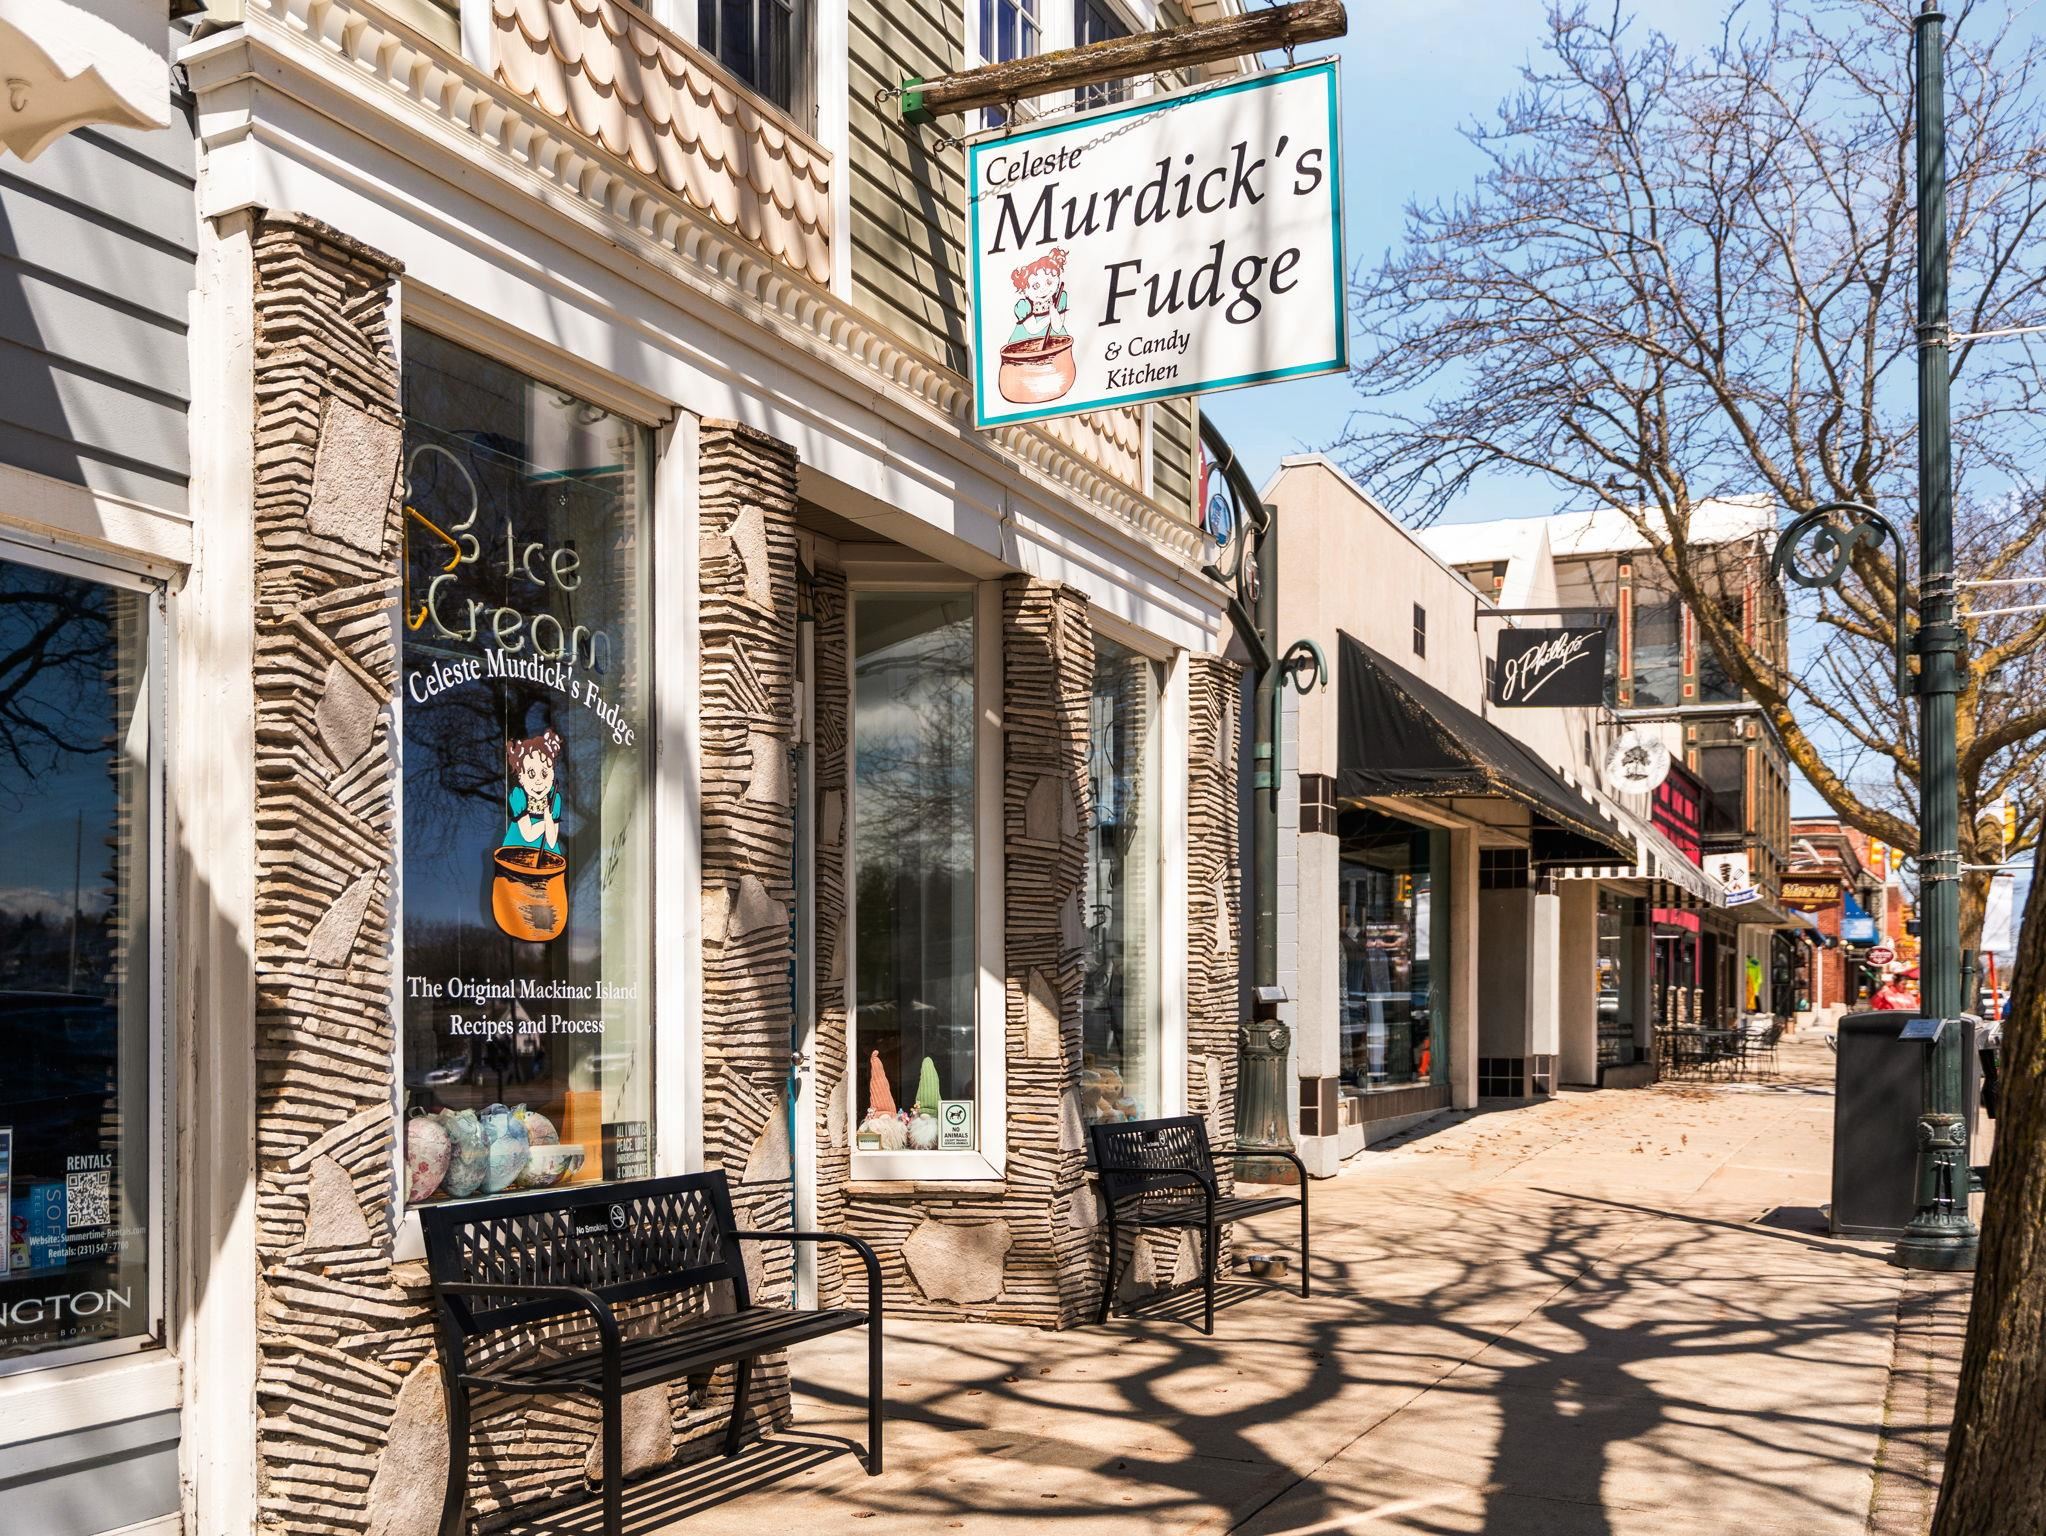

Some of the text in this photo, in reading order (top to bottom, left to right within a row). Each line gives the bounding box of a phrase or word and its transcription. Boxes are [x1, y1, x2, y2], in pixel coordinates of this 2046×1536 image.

[985, 145, 1083, 187] Celeste
[987, 135, 1323, 256] Murdick's
[1098, 239, 1301, 327] Fudge
[1104, 329, 1191, 362] & Candy
[1105, 363, 1179, 391] Kitchen
[504, 517, 582, 592] Ice
[428, 573, 612, 675] Cream
[1502, 631, 1602, 700] J Phillips
[409, 647, 636, 746] Celeste Murdick's Fudge
[406, 975, 638, 1006] The Original Mackinac Island
[450, 1014, 606, 1042] Recipes and Process
[66, 1153, 112, 1171] RENTALS
[621, 1163, 647, 1178] CHOCOLATE
[29, 1234, 60, 1246] Website:
[576, 1223, 609, 1236] No Smoking
[48, 1246, 77, 1259] Rentals:
[77, 1243, 95, 1257] (231)
[95, 1242, 108, 1253] 547
[0, 1286, 132, 1328] GTON
[60, 1323, 105, 1337] BOATS
